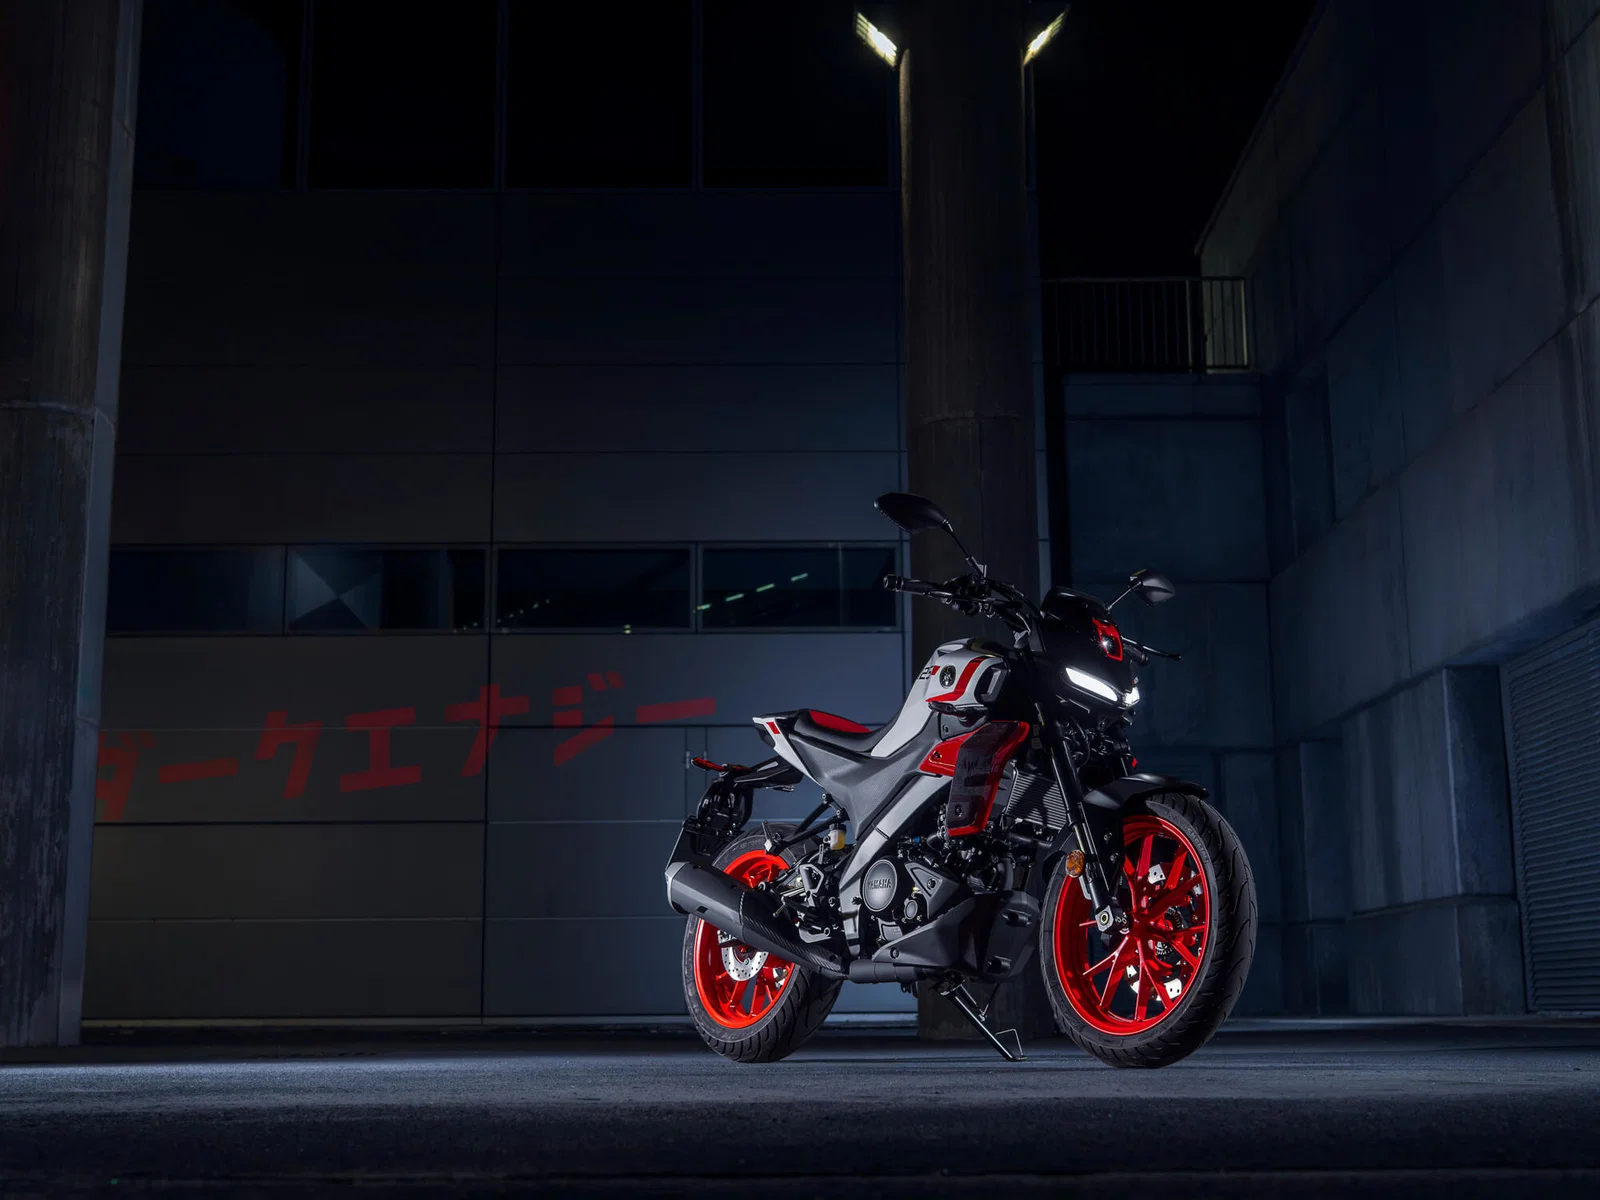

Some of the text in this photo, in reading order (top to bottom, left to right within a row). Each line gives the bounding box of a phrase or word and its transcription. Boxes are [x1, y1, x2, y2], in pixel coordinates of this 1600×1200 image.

[96, 671, 717, 822] ダークエナジー
